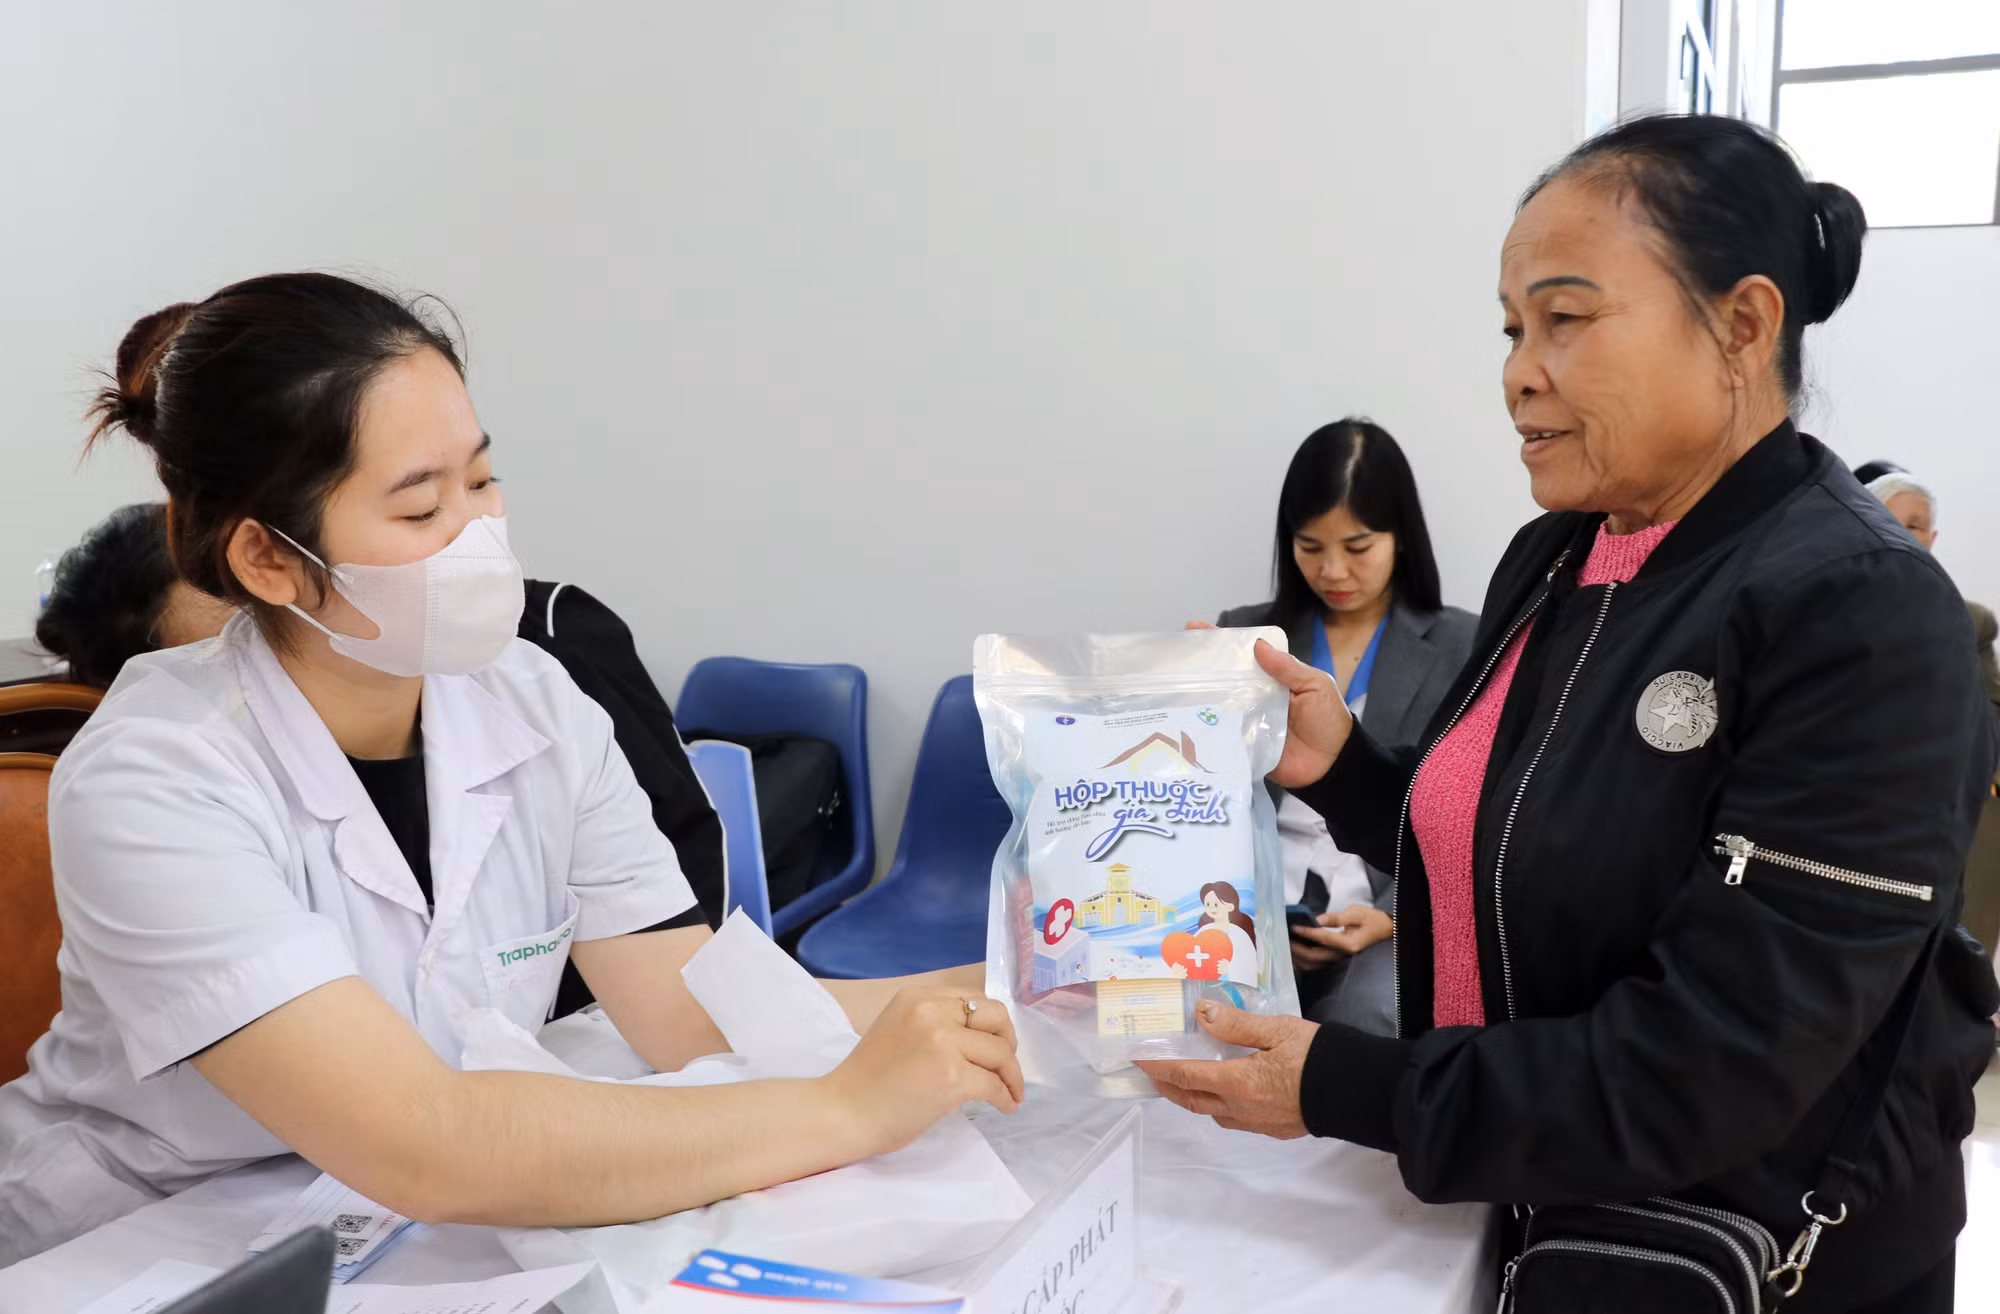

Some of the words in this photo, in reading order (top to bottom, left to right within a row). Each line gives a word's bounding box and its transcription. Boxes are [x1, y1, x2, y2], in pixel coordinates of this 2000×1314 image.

[1653, 676, 1665, 687] SU
[1055, 779, 1109, 807] HỘP
[1114, 779, 1206, 800] THUỐC
[1068, 1200, 1118, 1279] PHÁT
